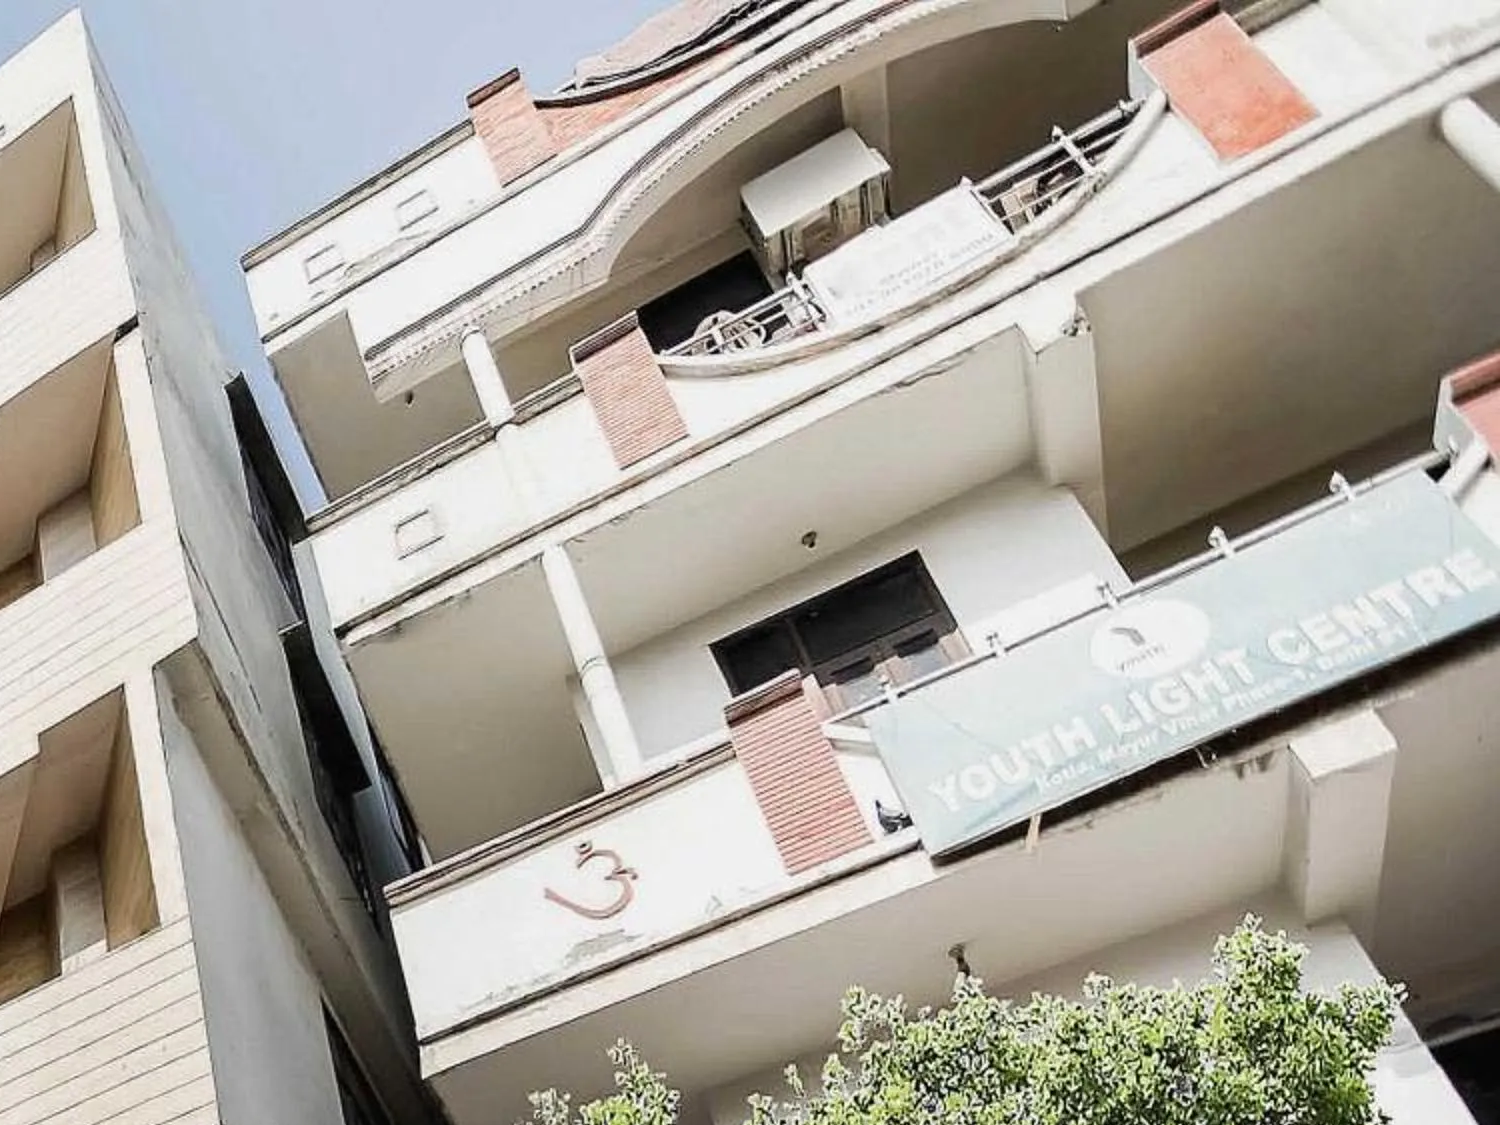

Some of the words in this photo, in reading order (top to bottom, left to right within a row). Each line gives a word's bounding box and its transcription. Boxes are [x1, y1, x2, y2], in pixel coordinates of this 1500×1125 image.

[929, 716, 1097, 812] YOUTH
[1100, 648, 1255, 733] LIGHT
[1266, 547, 1499, 665] CENTRE
